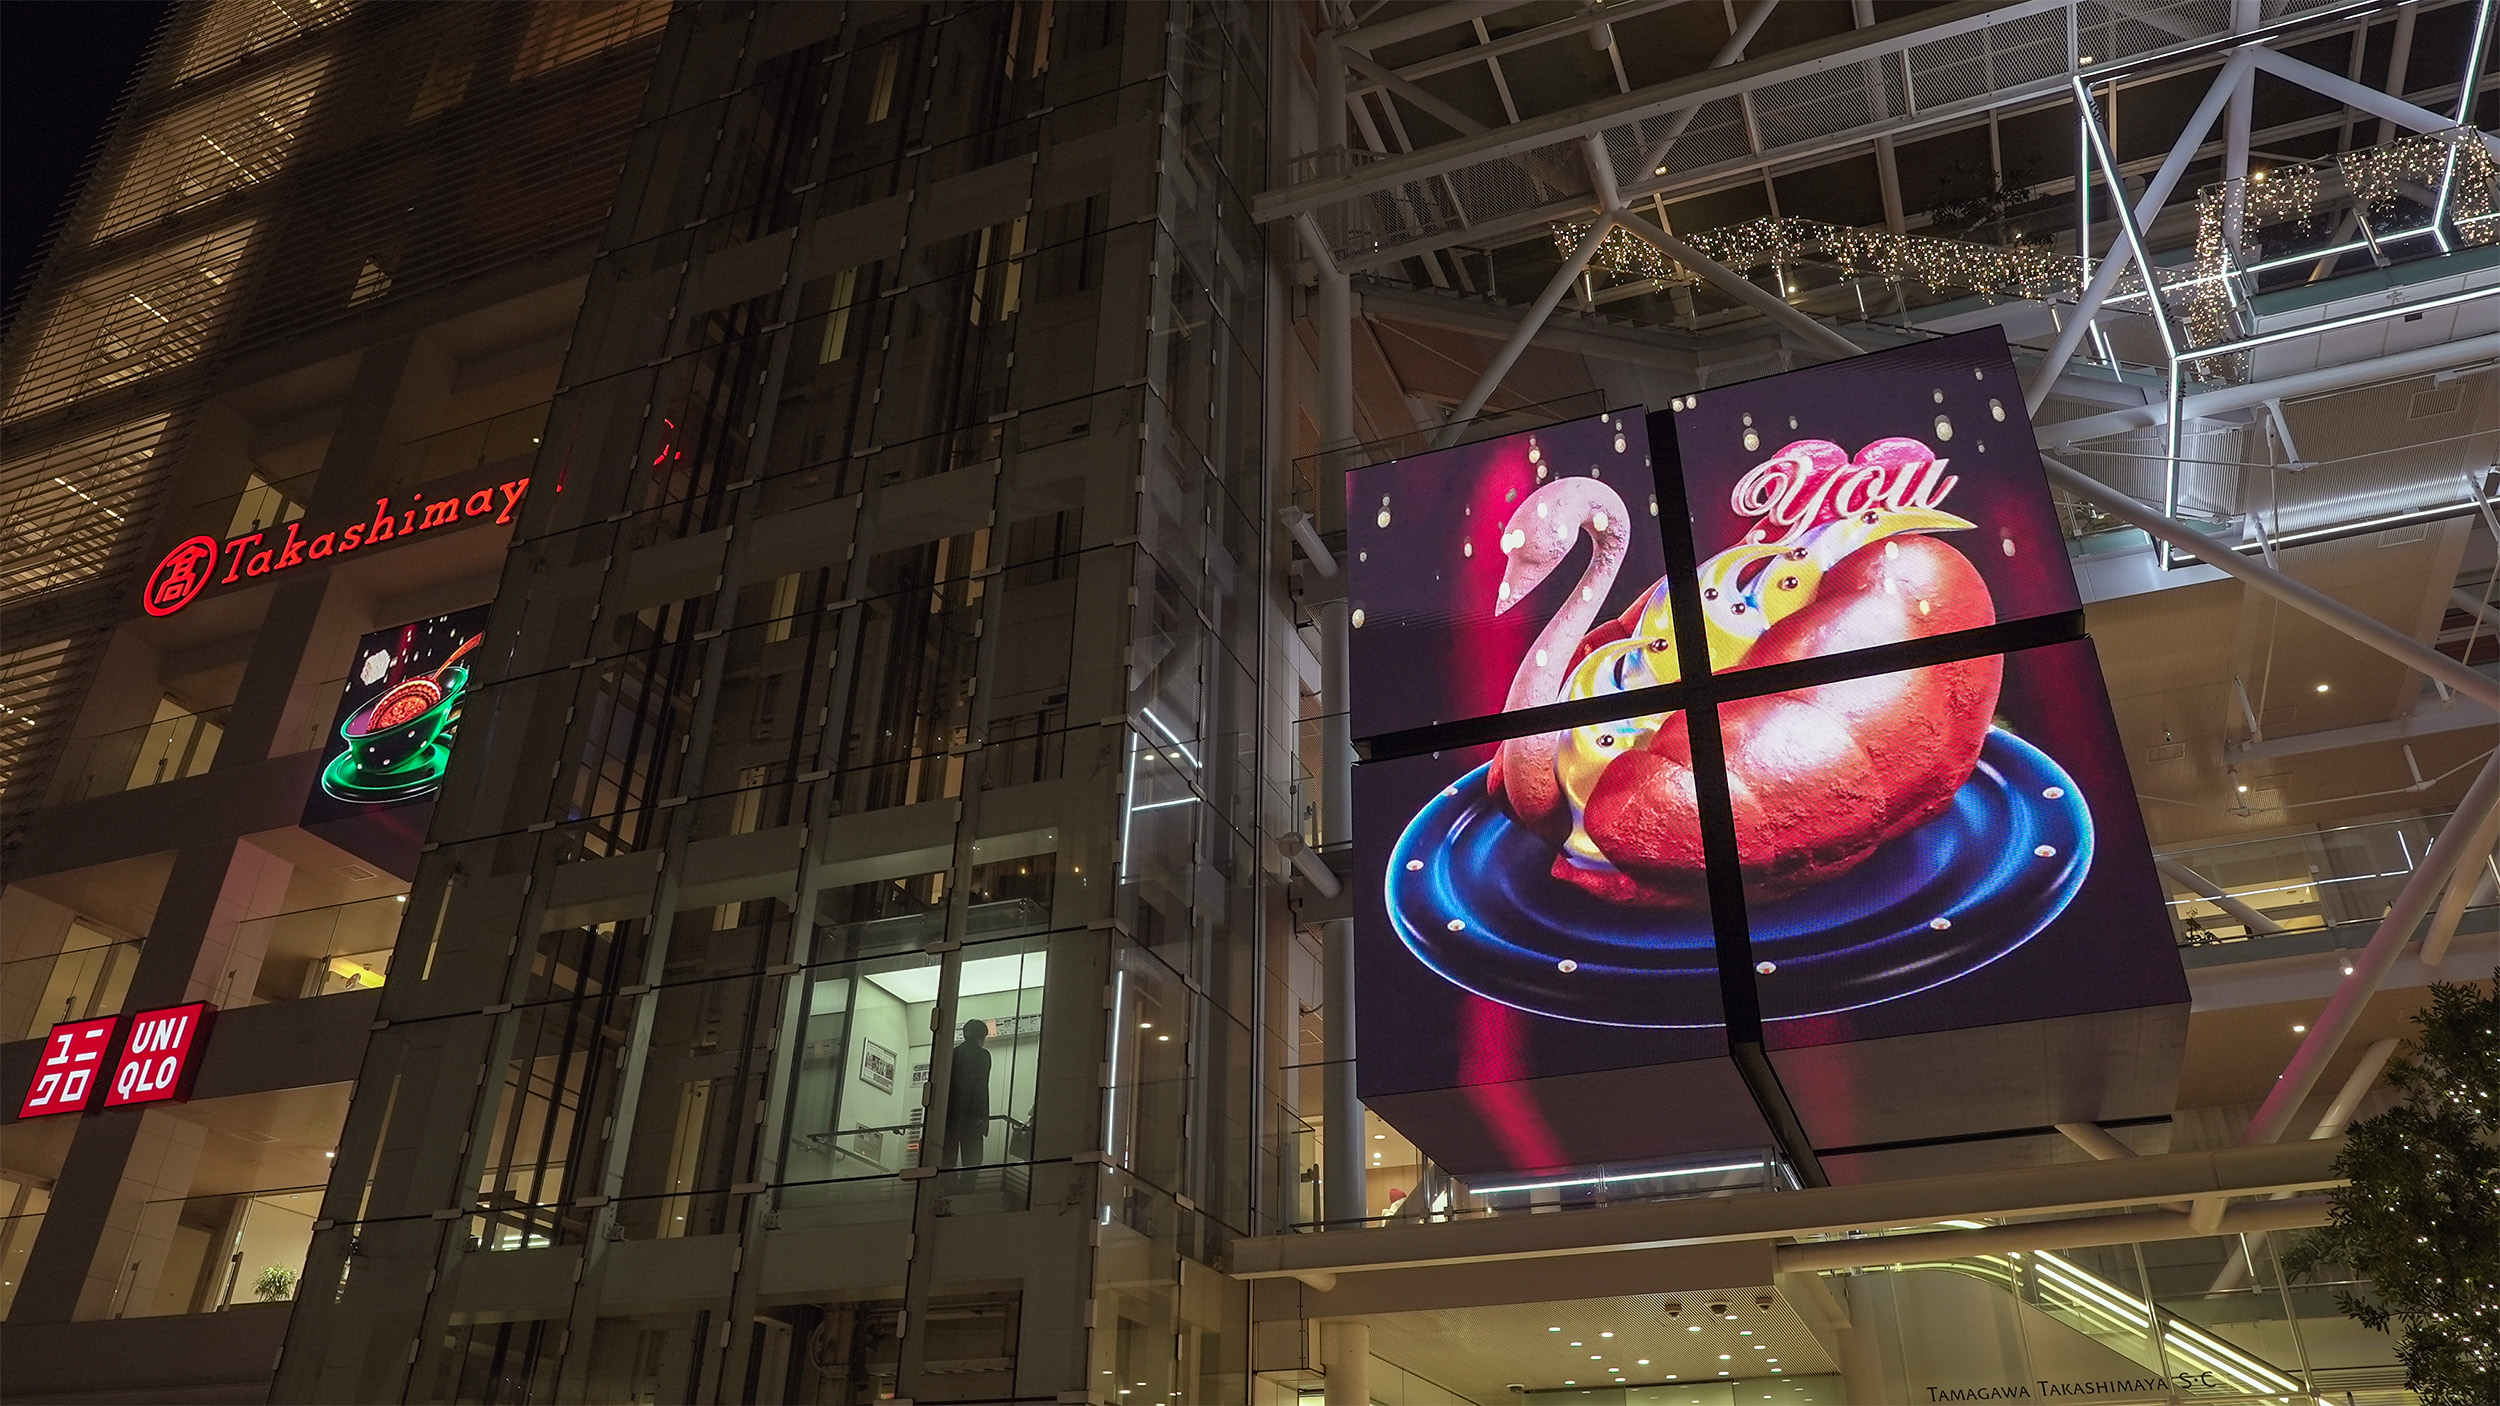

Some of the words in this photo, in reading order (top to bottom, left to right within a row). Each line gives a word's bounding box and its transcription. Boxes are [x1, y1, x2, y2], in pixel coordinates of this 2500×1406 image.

[1731, 455, 1959, 546] You
[222, 478, 530, 583] Takashimay
[132, 1016, 189, 1054] UNI
[117, 1055, 177, 1100] QLO
[1926, 1386, 2031, 1402] TAMAGAWA
[2037, 1378, 2169, 1397] TAKASHIMAYA
